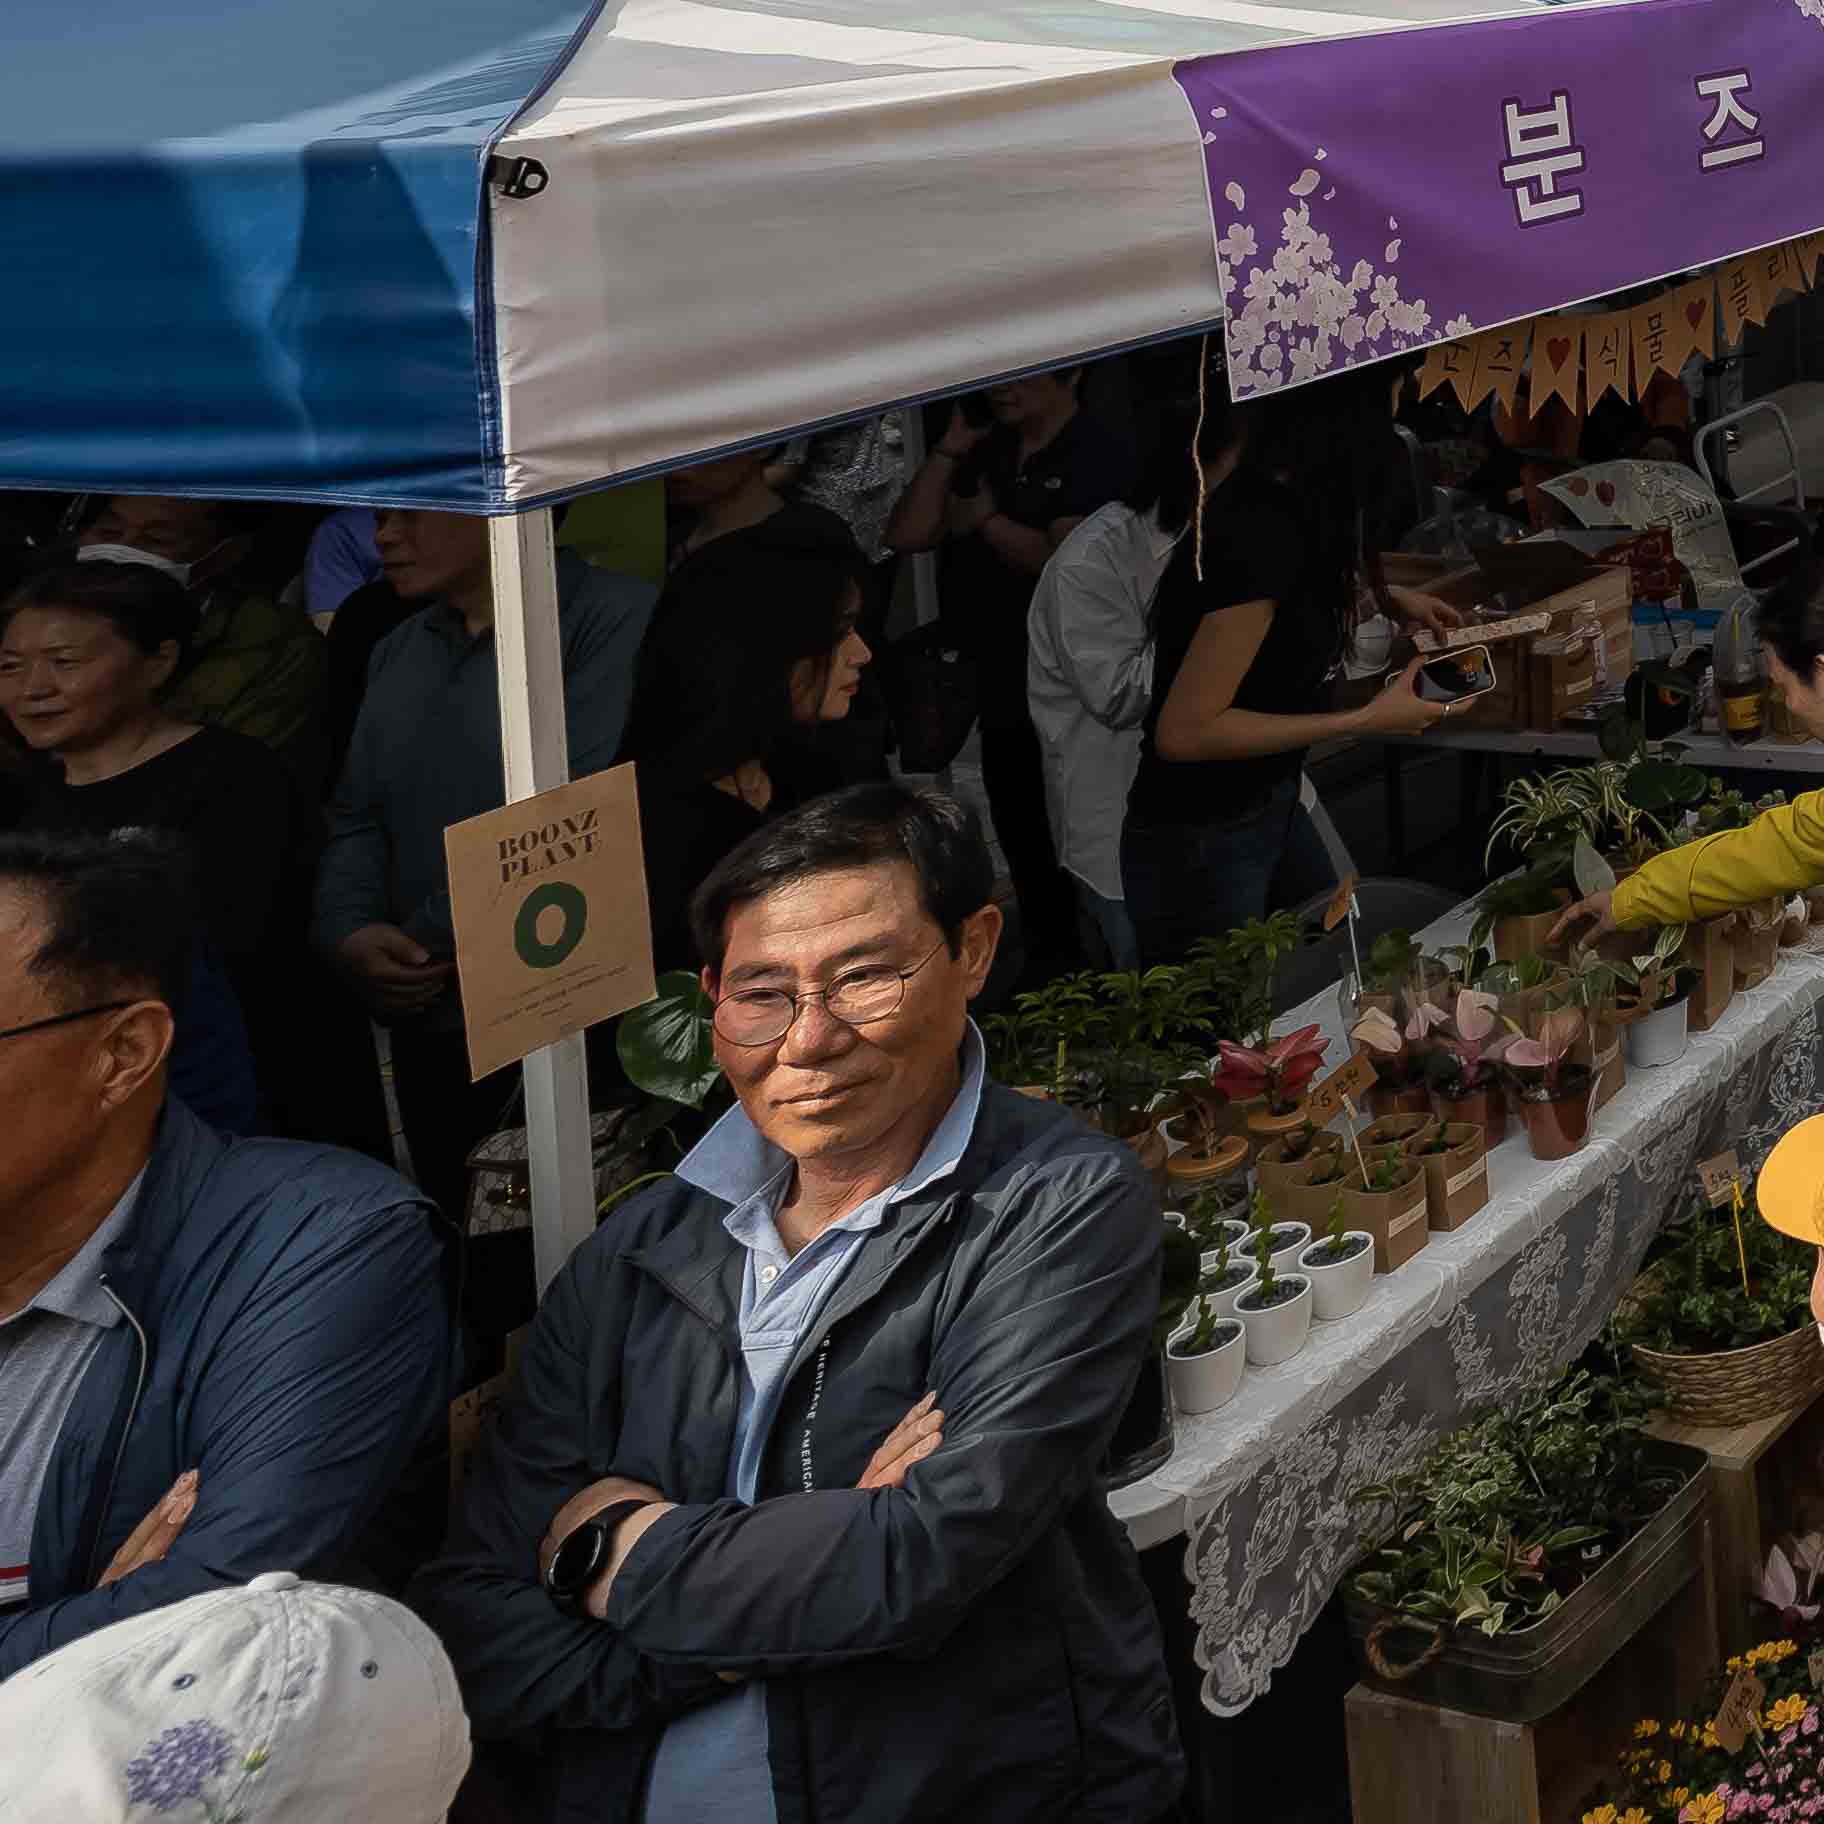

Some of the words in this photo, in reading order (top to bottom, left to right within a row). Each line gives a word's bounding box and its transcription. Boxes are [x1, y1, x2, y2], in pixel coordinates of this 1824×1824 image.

[497, 807, 600, 862] BOONZ
[500, 831, 602, 883] PLANT
[799, 1428, 816, 1494] AMERICA
